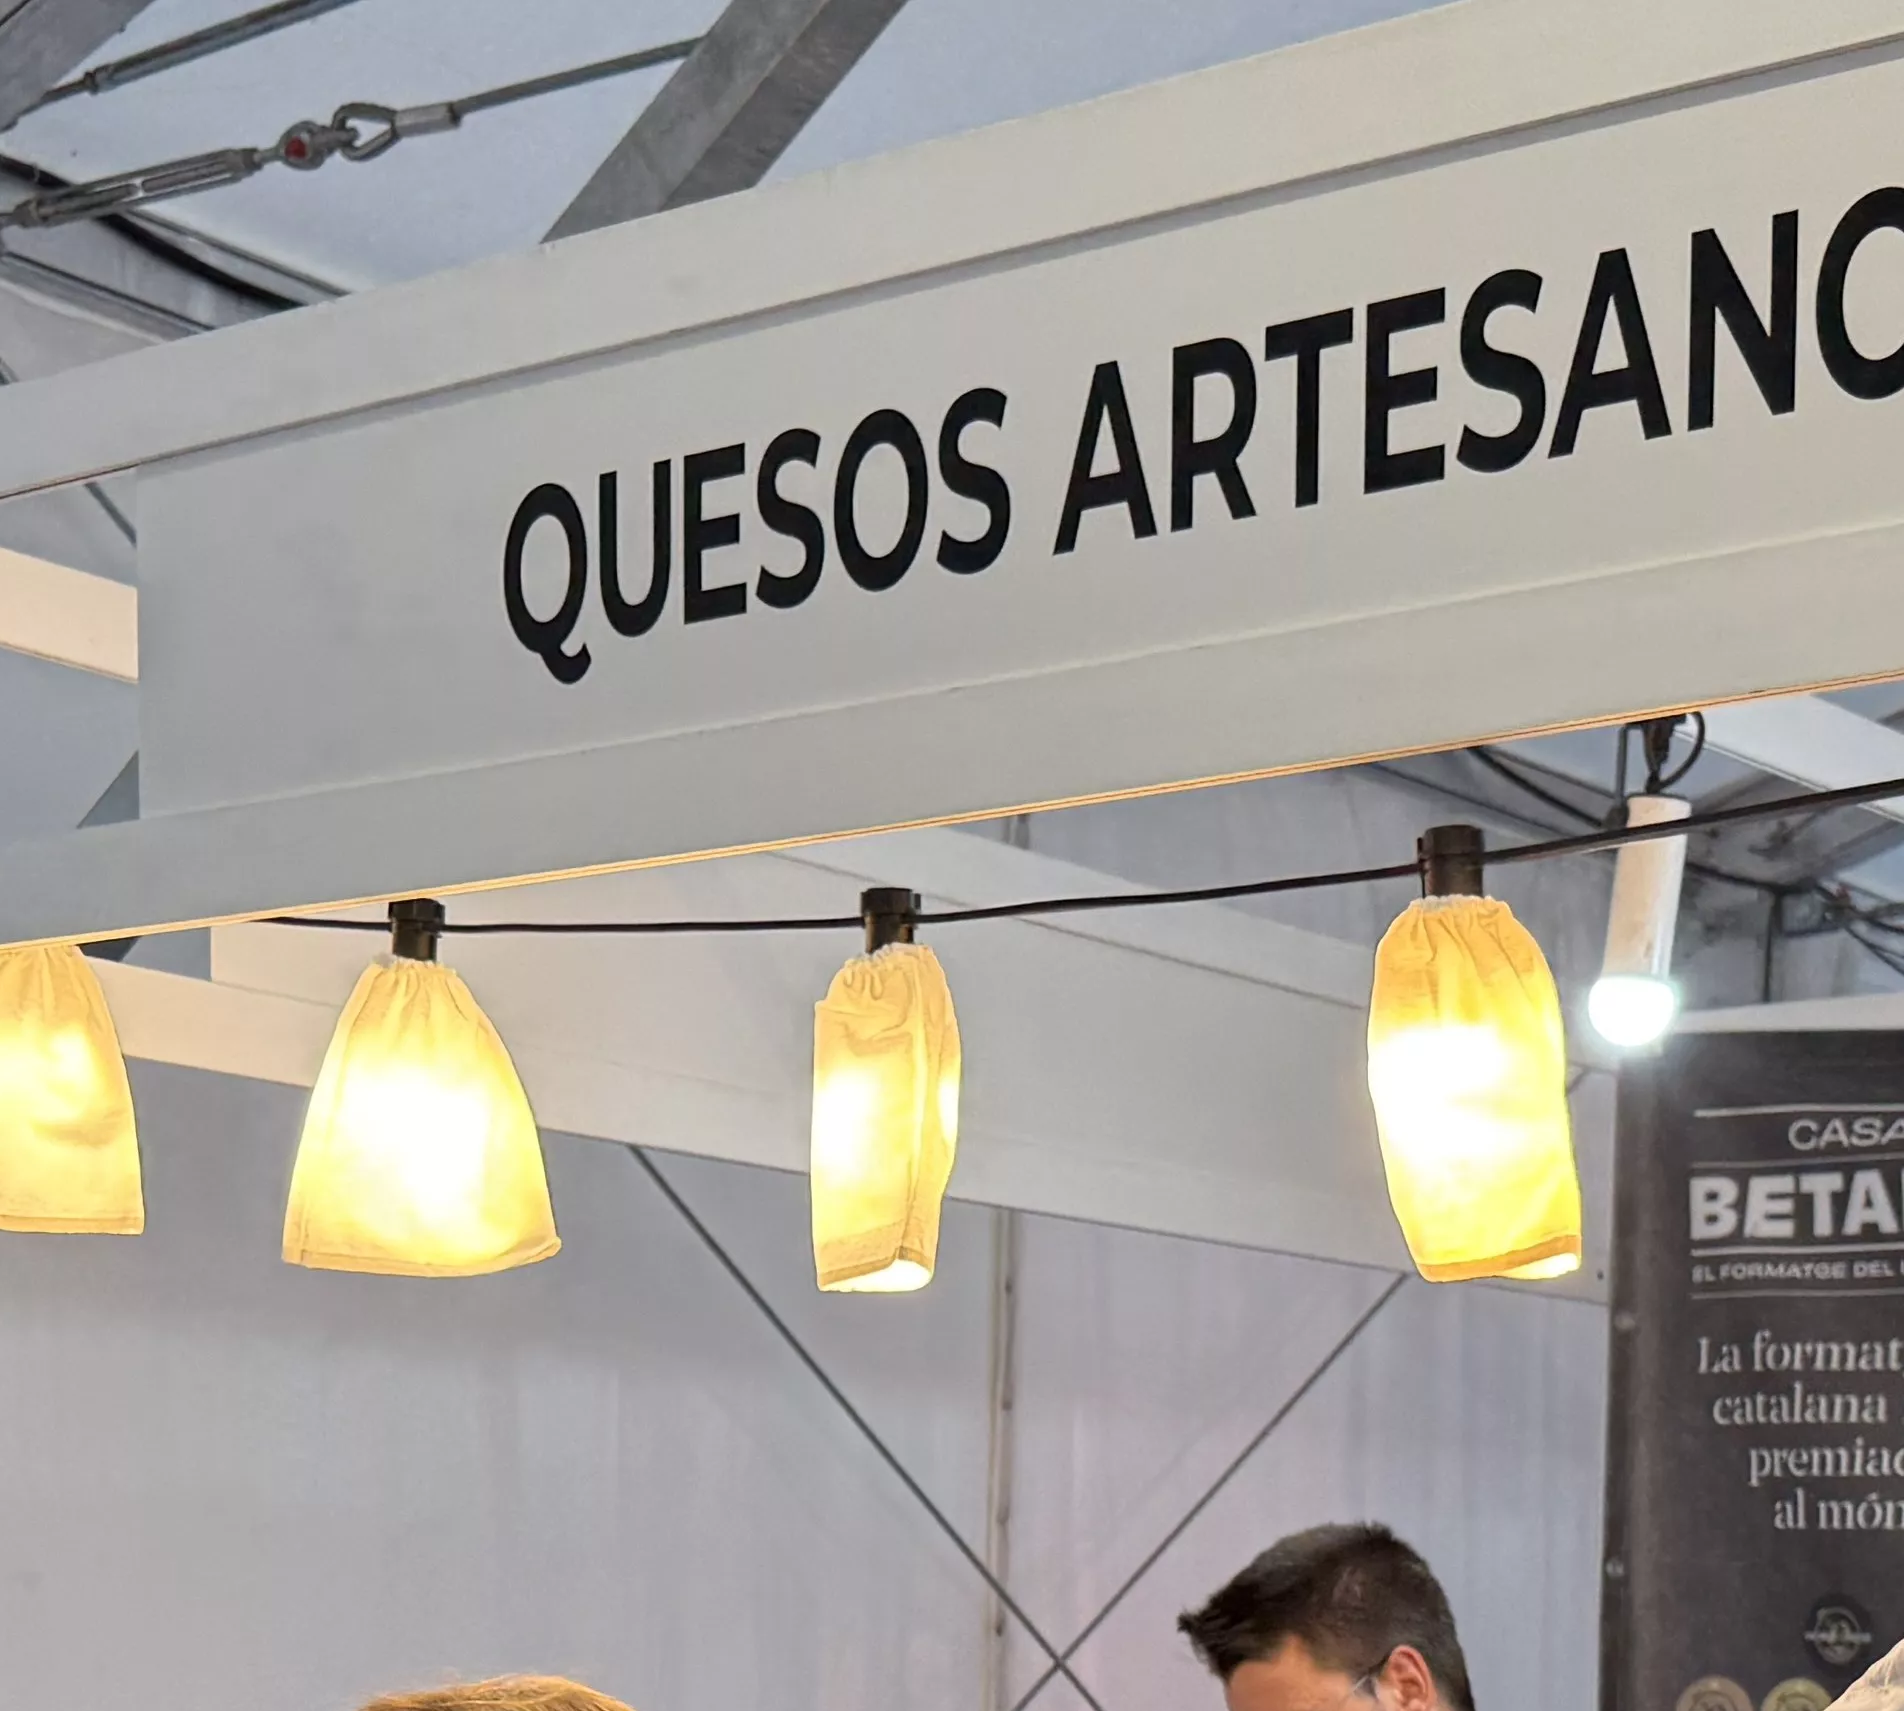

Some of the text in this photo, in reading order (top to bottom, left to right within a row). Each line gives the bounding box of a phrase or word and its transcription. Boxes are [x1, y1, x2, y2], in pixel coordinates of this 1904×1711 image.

[503, 386, 1012, 685] QUESOS
[1692, 1264, 1716, 1283] EL
[1853, 1259, 1895, 1278] DEL
[1698, 1336, 1741, 1374] La
[1712, 1380, 1887, 1425] catalana
[1773, 1487, 1807, 1530] al
